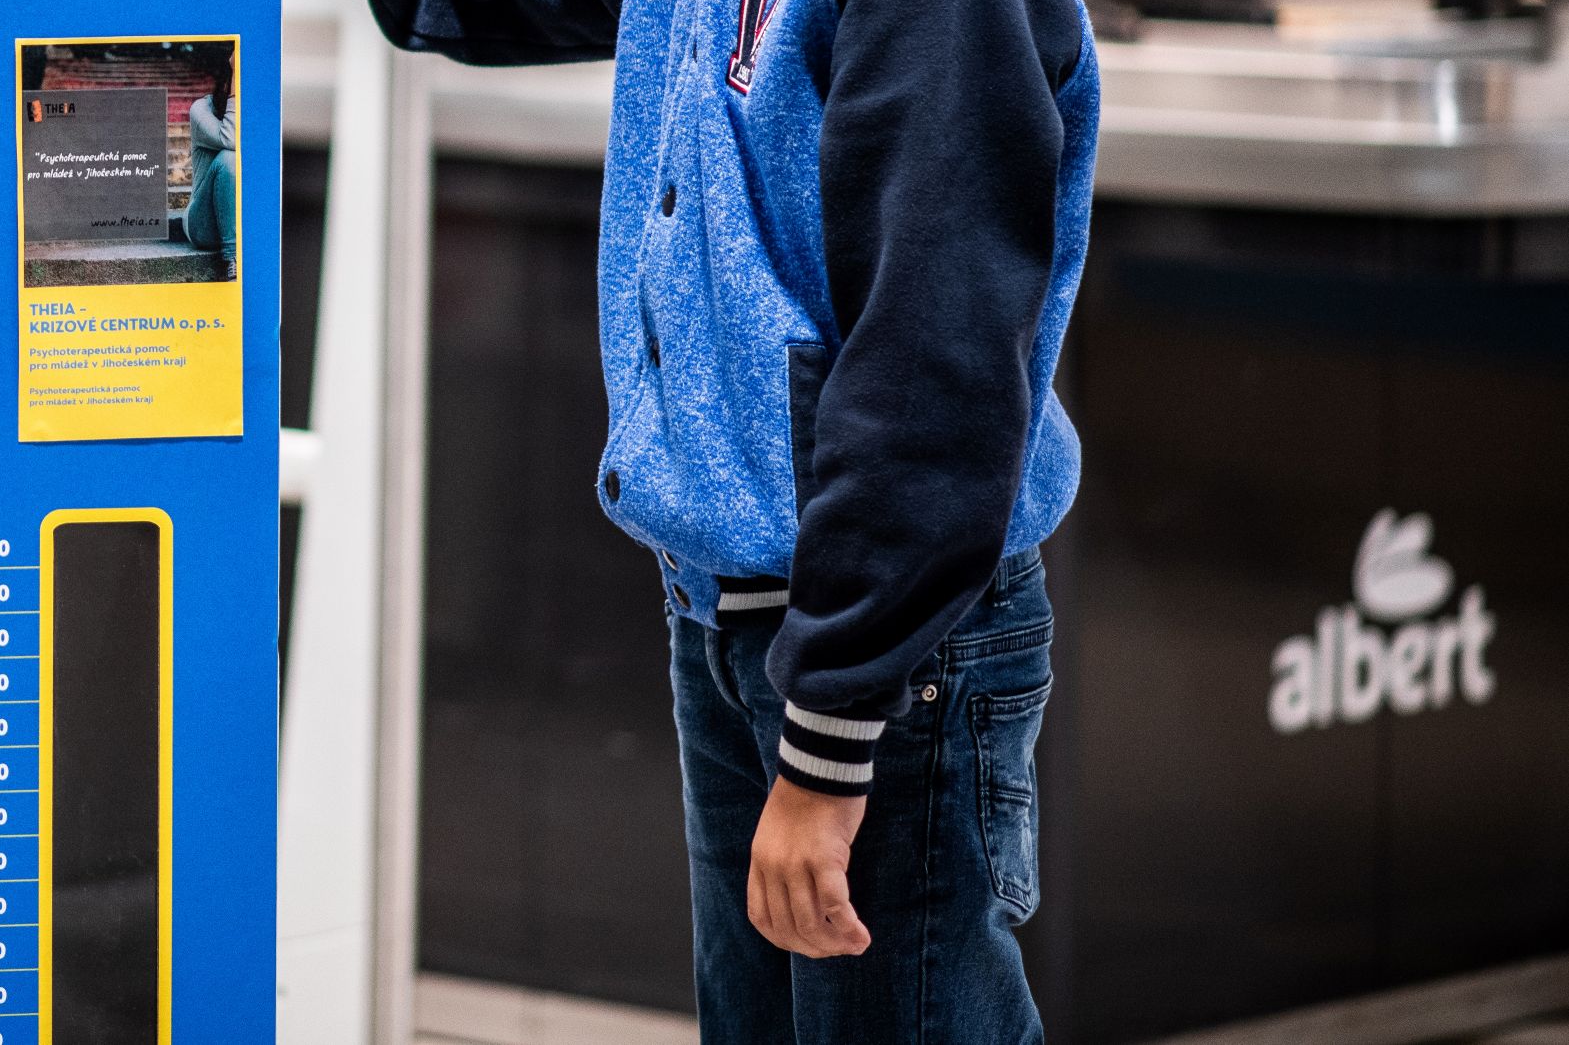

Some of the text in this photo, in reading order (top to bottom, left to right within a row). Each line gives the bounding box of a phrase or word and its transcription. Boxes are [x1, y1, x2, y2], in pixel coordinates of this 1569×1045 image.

[123, 153, 147, 162] pomoc
[27, 171, 40, 181] pro
[43, 168, 74, 179] mládež
[91, 216, 160, 228] www.theia.cz
[29, 303, 75, 316] THEIA
[29, 317, 97, 334] KRIZOVÉ
[100, 317, 175, 331] CENTRUM
[29, 345, 170, 358] Psychoterapeutická pomoc
[29, 361, 48, 372] pro
[50, 359, 88, 370] mládež
[101, 357, 160, 368] Jihočeském
[163, 356, 187, 367] kraji
[29, 385, 141, 396] Psychoterapeutická pomoc
[29, 399, 44, 407] pro
[46, 397, 76, 406] mládež
[86, 396, 134, 405] Jihočeském
[135, 396, 153, 404] kraji
[1267, 584, 1497, 735] albert
